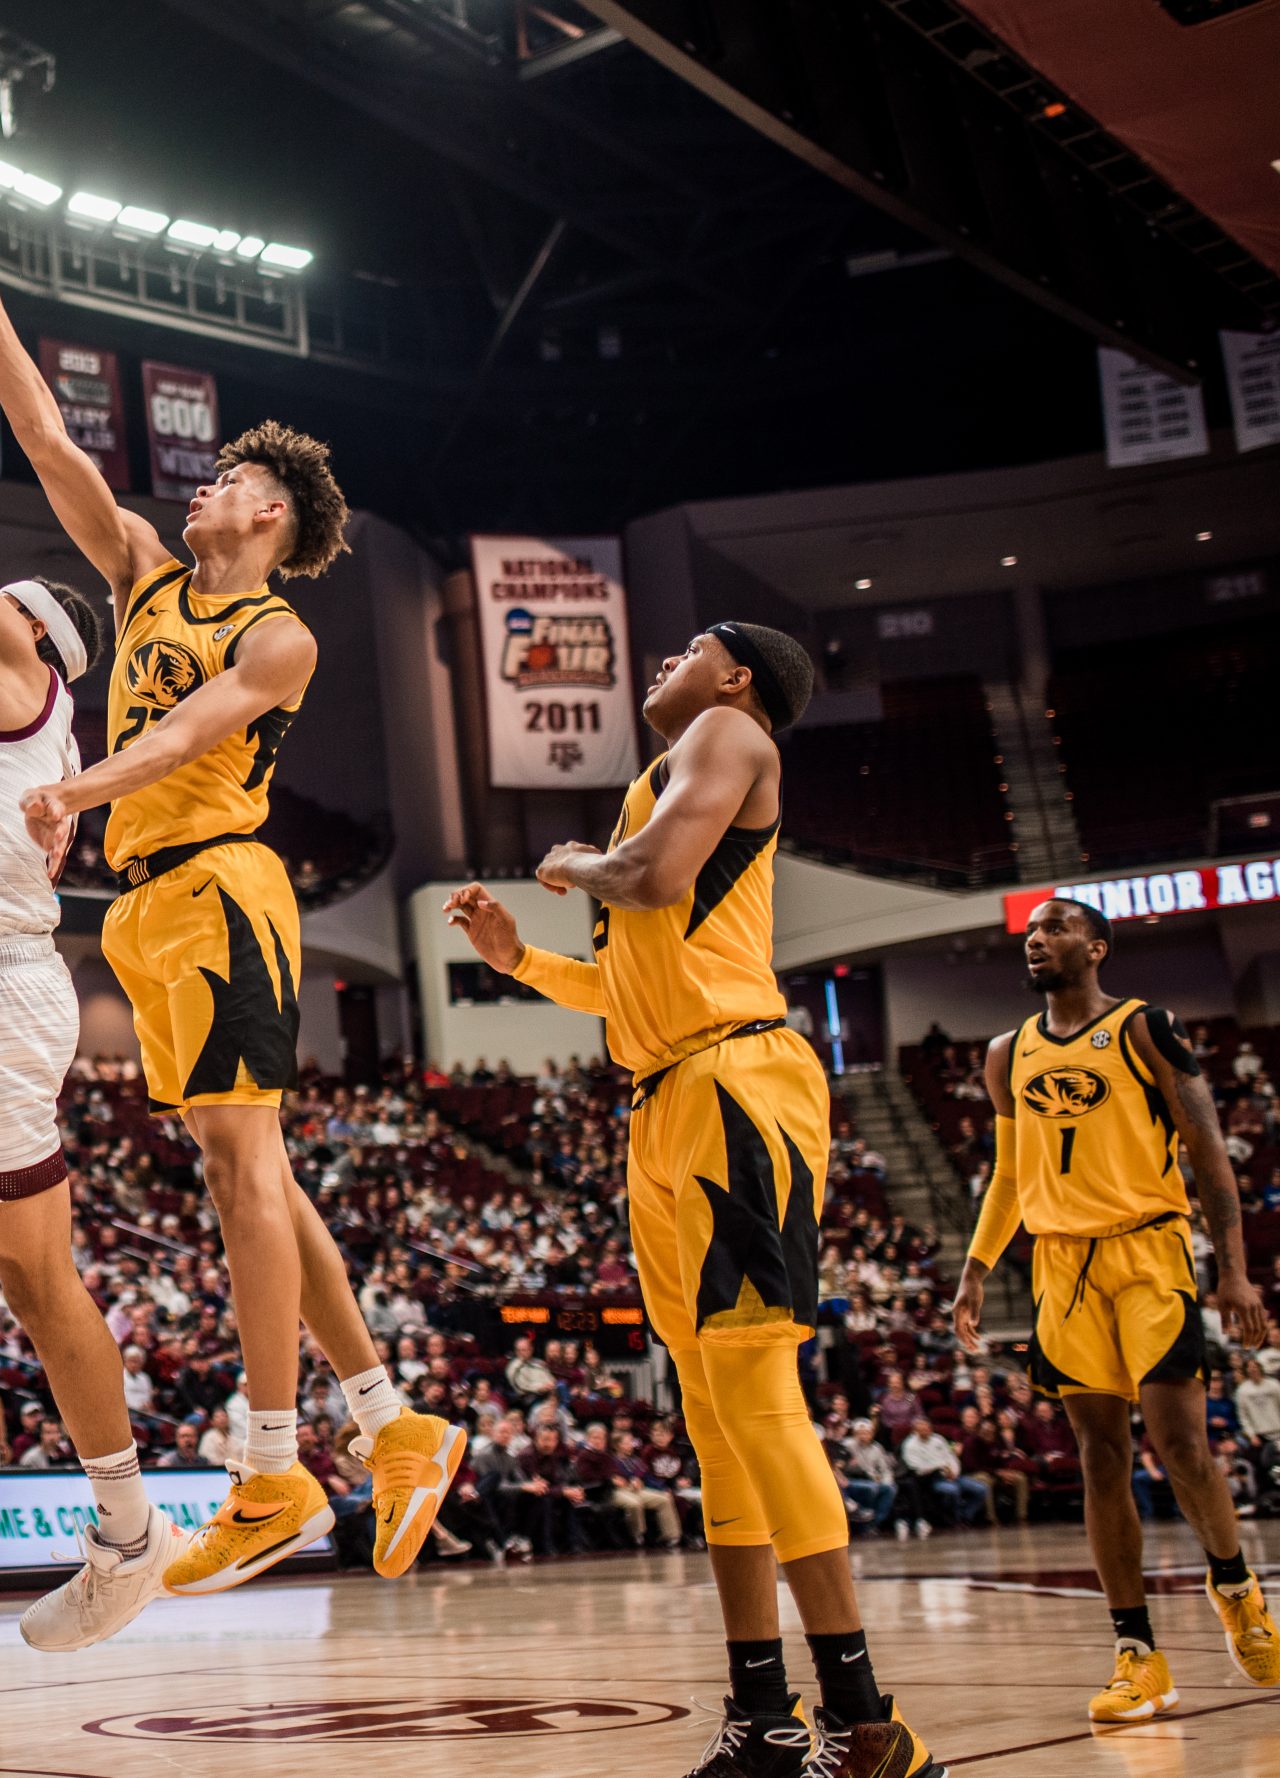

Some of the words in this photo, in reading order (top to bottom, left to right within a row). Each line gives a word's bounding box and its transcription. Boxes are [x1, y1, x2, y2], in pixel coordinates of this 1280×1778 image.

[151, 394, 216, 442] 800
[502, 559, 594, 577] NATIONAL
[491, 582, 609, 601] CHAMPIONS
[525, 702, 600, 732] 2011
[1216, 859, 1280, 905] AG
[1060, 1126, 1076, 1175] 1
[33, 1508, 54, 1538] &
